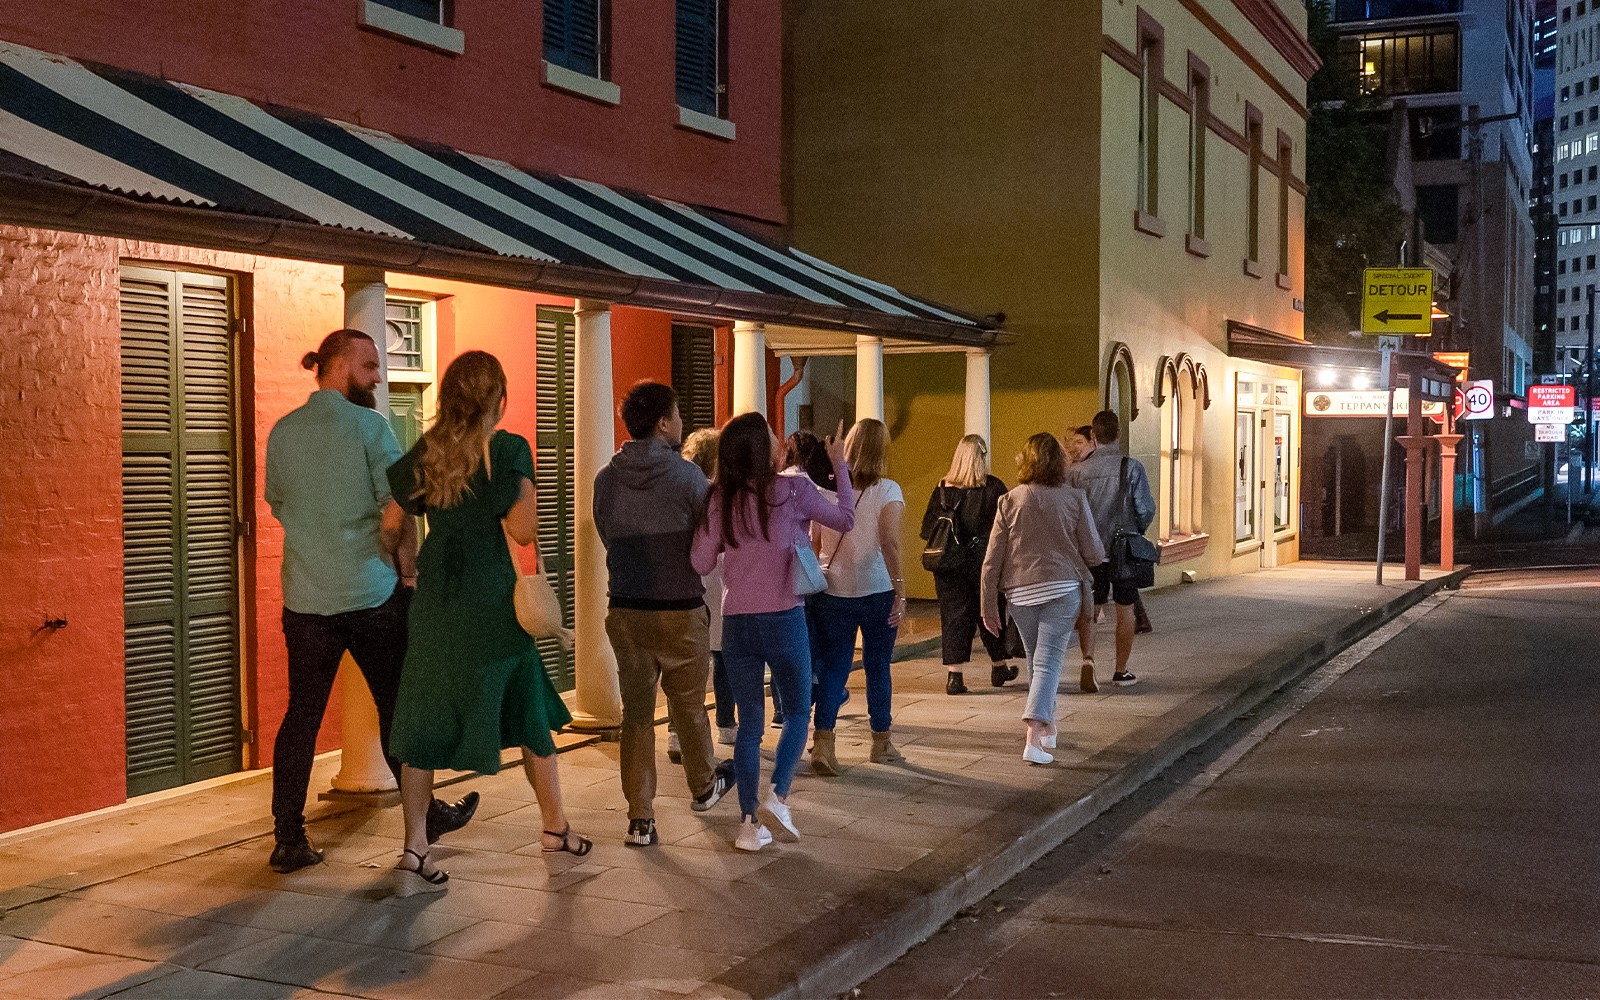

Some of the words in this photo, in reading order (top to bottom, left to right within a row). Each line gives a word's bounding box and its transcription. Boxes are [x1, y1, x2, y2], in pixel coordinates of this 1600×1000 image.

[1369, 284, 1428, 296] DETOUR
[1468, 393, 1488, 406] 40
[1340, 402, 1408, 410] TEPPANYKI
